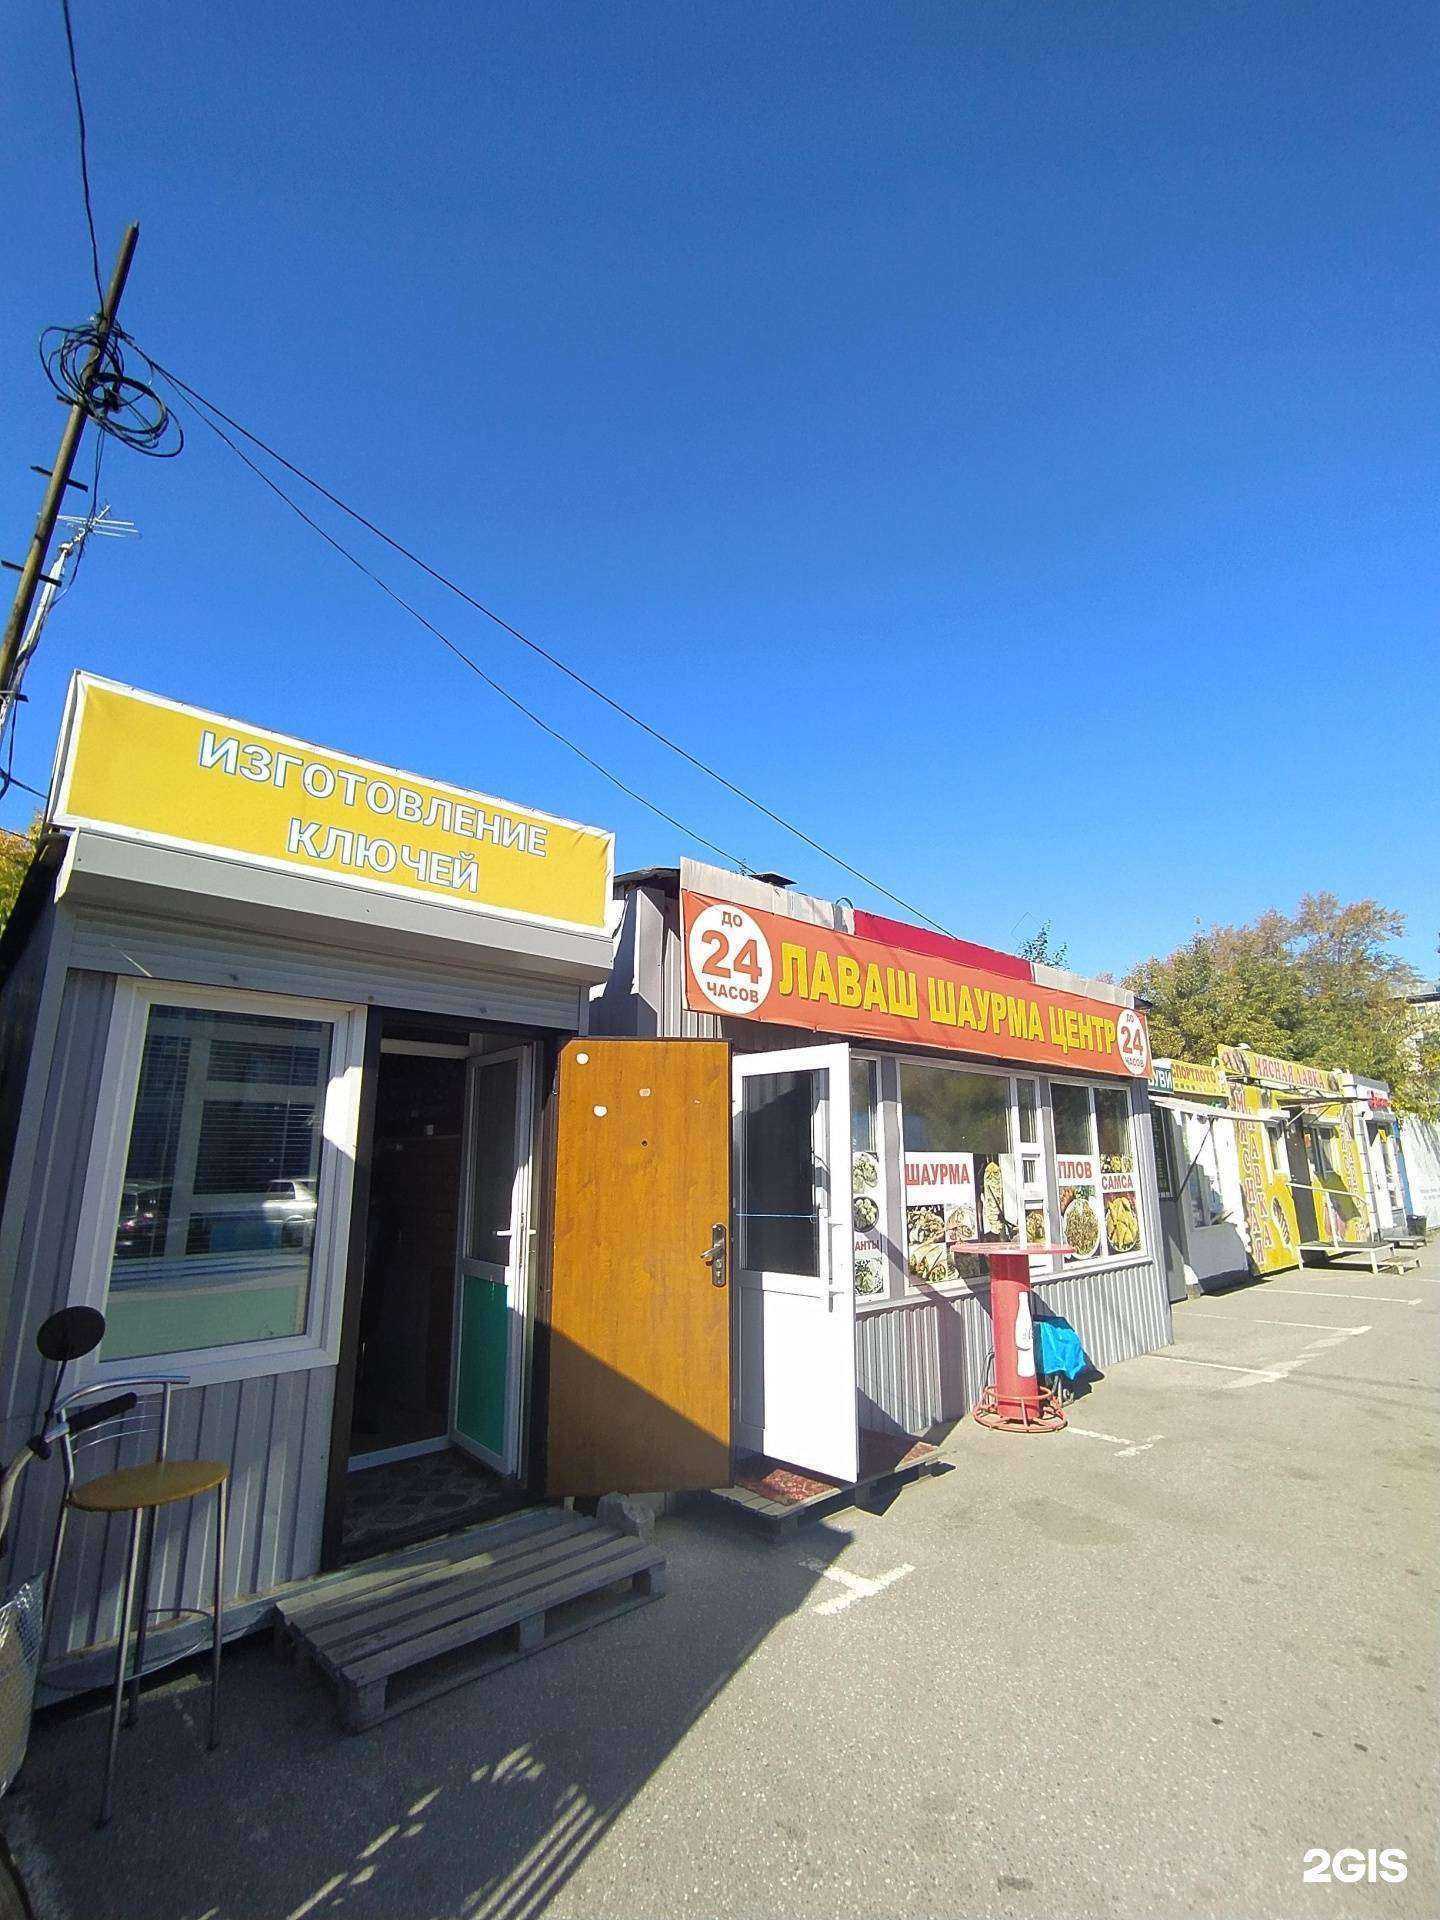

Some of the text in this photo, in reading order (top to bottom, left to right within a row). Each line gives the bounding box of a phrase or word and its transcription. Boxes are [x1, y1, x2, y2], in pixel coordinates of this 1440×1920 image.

[198, 729, 548, 858] ИЗГОТОВЛЕНИЕ
[286, 817, 479, 893] КЛЮЧЕЙ
[720, 909, 743, 929] ДО
[701, 929, 763, 984] 24
[706, 981, 760, 1004] ЧАСОВ
[778, 942, 1116, 1054] ЛАВАШ ШАУРМА ЦЕНТР
[1120, 1026, 1144, 1056] 24
[904, 1162, 971, 1186] ШАУРМА
[1057, 1161, 1093, 1180] ПЛОВ
[1101, 1174, 1134, 1190] САМСА
[854, 1239, 880, 1252] АНТЫ
